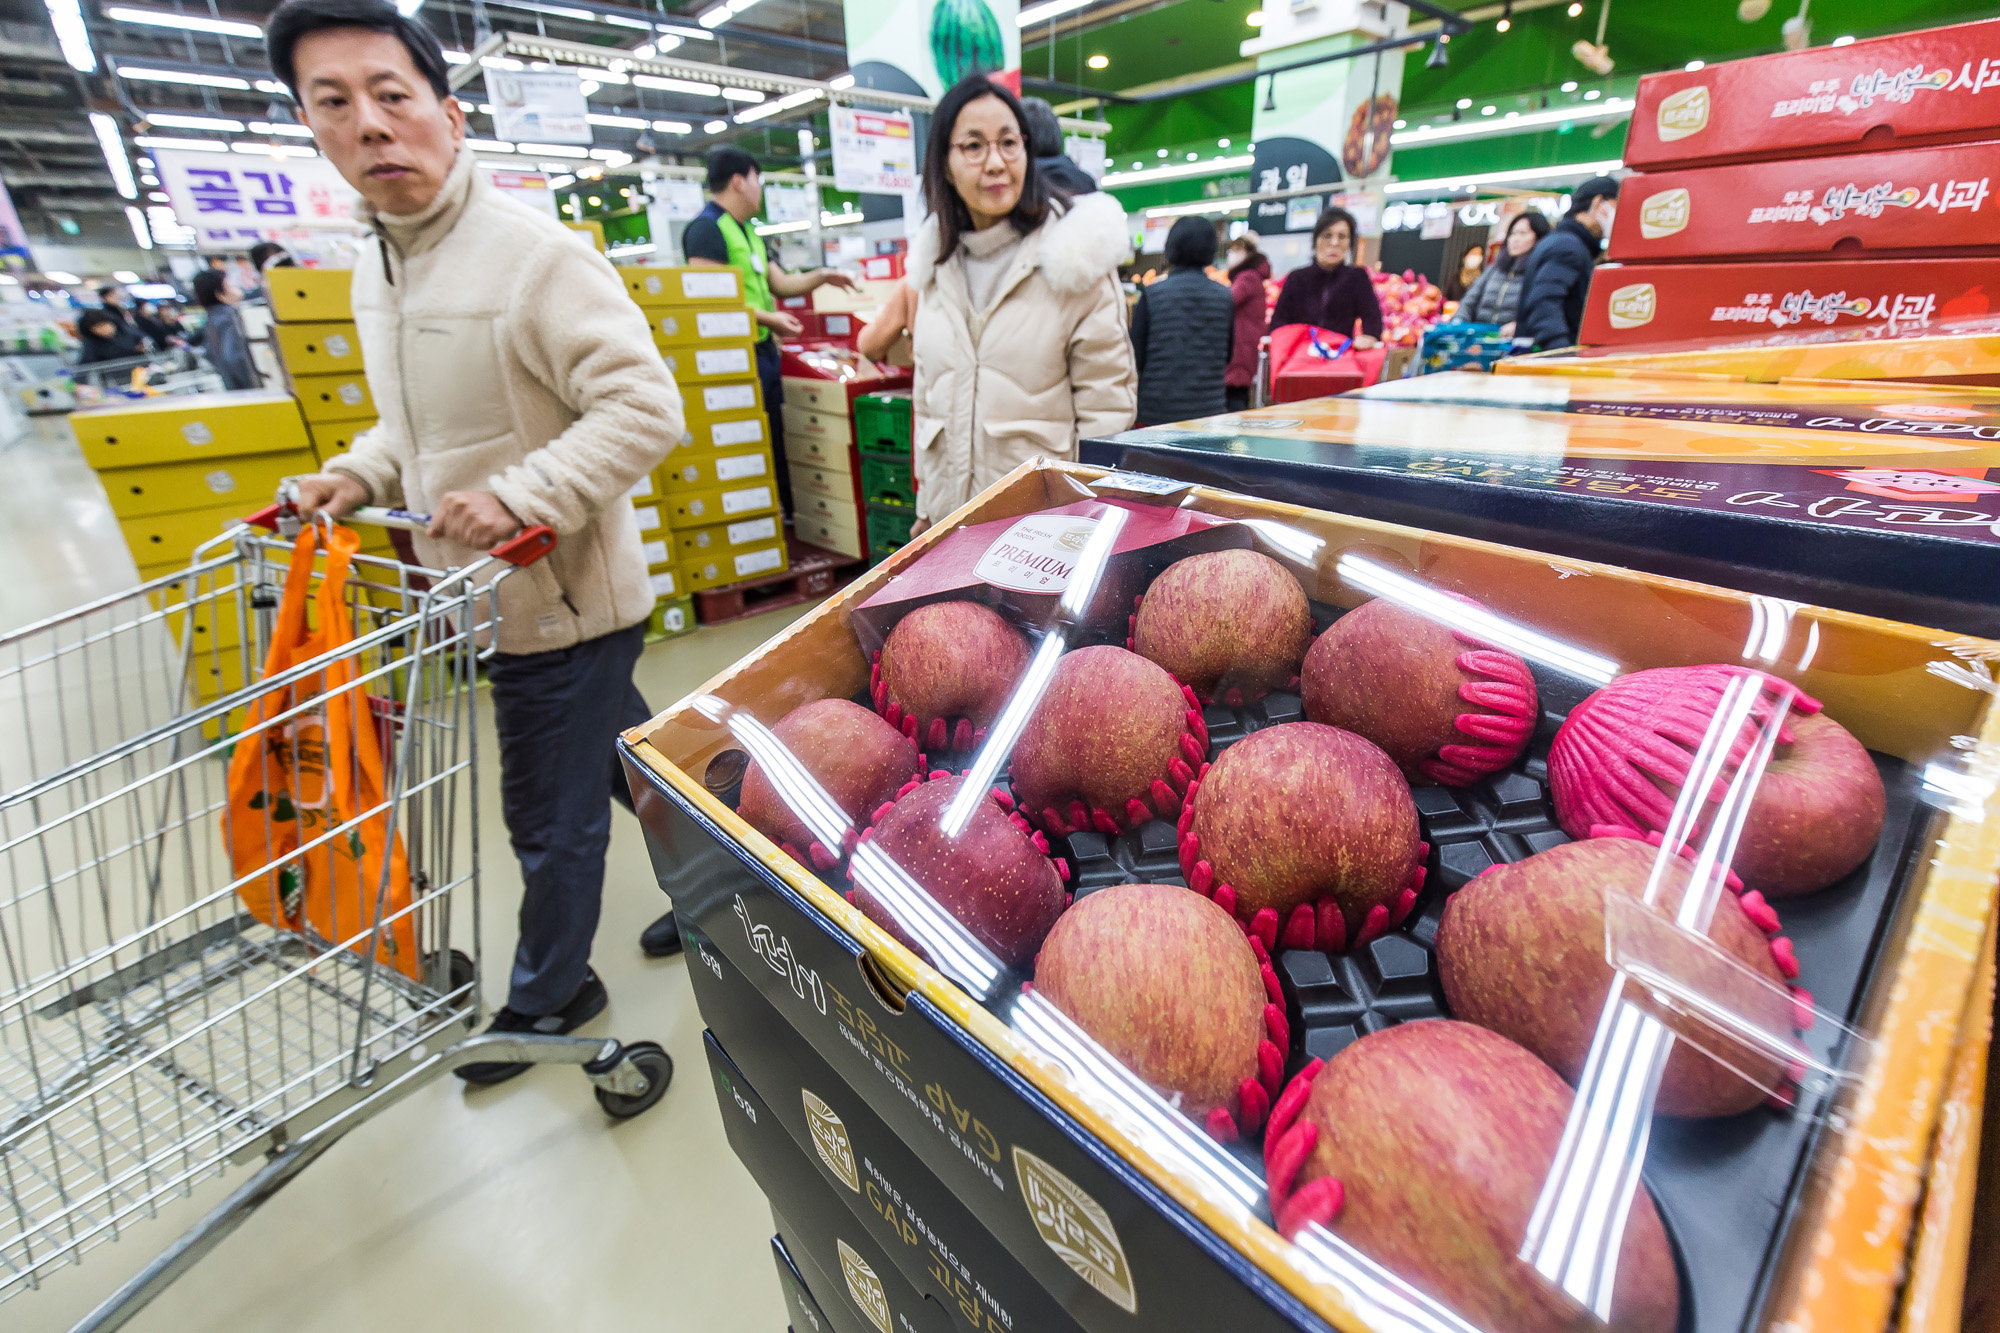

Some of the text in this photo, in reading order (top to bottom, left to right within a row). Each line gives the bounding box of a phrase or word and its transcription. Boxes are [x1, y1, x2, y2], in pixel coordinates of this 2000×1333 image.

[1770, 94, 1838, 118] 프리미엄
[187, 168, 297, 216] 곶감
[1915, 177, 1990, 214] 사과
[1747, 204, 1812, 225] 프리미엄
[1710, 306, 1769, 323] 프리미엄
[1867, 293, 1936, 329] 사과
[1406, 461, 1516, 477] GAP
[1525, 475, 1704, 501] 고당도
[1014, 532, 1035, 541] FOODS
[994, 544, 1075, 580] PREMIUM
[698, 943, 723, 981] 농협
[733, 893, 1001, 1163] 사과 고당도 GAP
[732, 1085, 757, 1124] 농협
[811, 1113, 852, 1174] 뜨라네
[866, 1180, 918, 1245] GAP
[1027, 1174, 1117, 1277] 뜨라네
